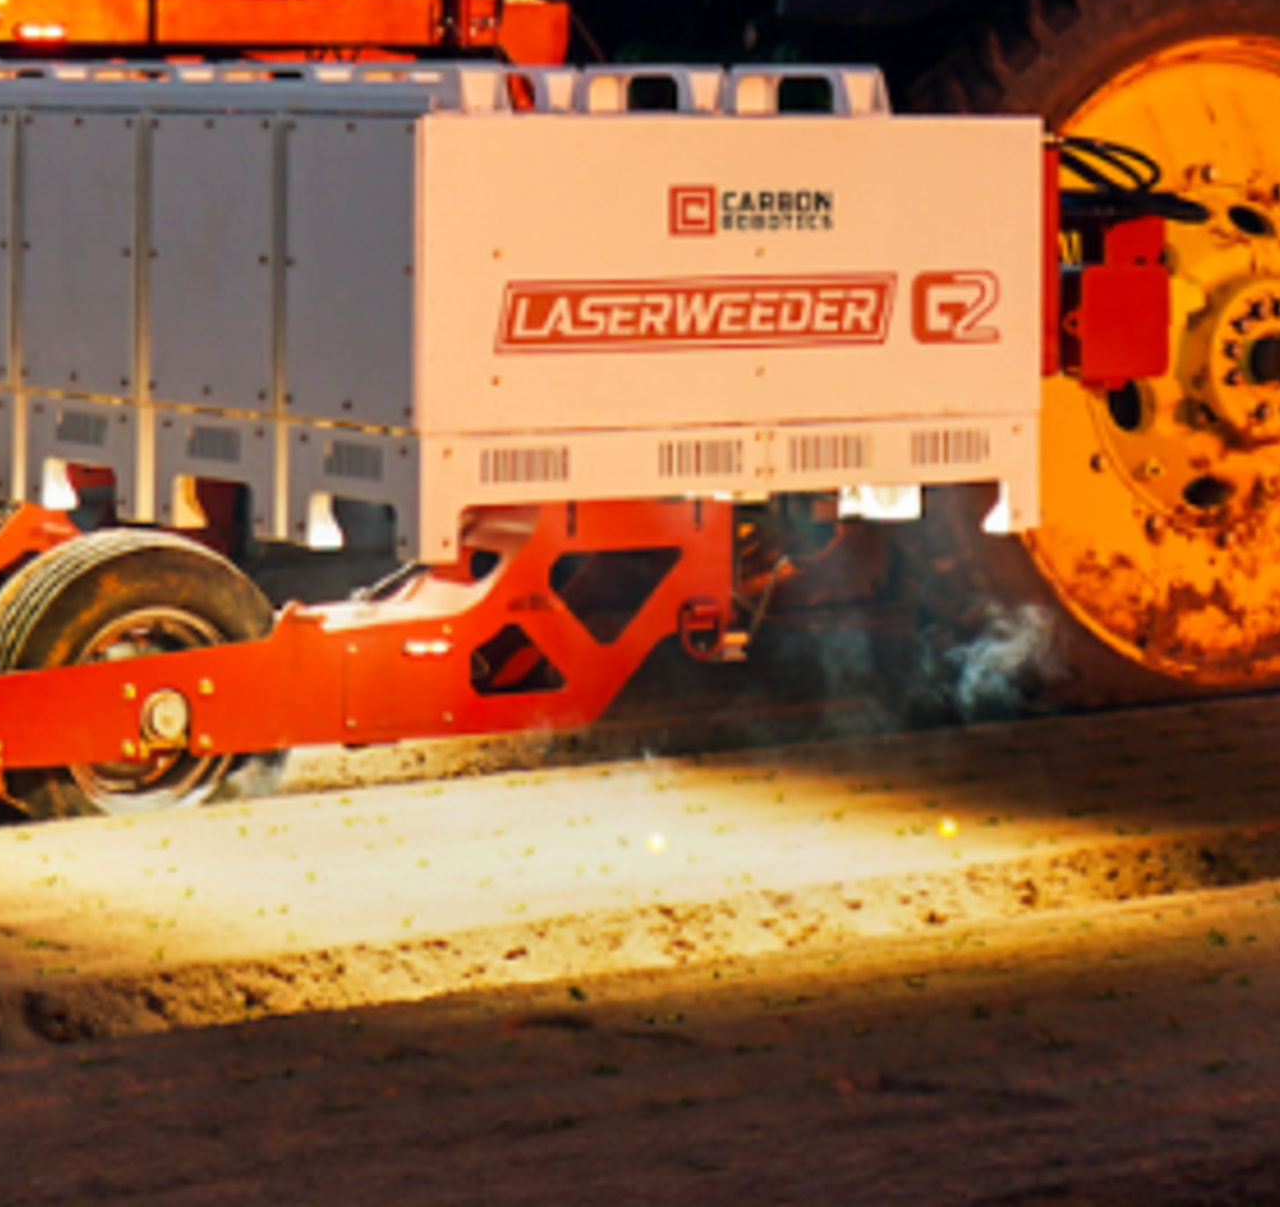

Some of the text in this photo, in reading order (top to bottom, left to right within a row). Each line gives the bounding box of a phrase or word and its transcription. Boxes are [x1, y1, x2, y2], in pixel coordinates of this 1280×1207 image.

[721, 190, 834, 212] CARBON
[721, 214, 834, 231] ROBOTICS
[512, 269, 1001, 344] LASERWEEDER G2
